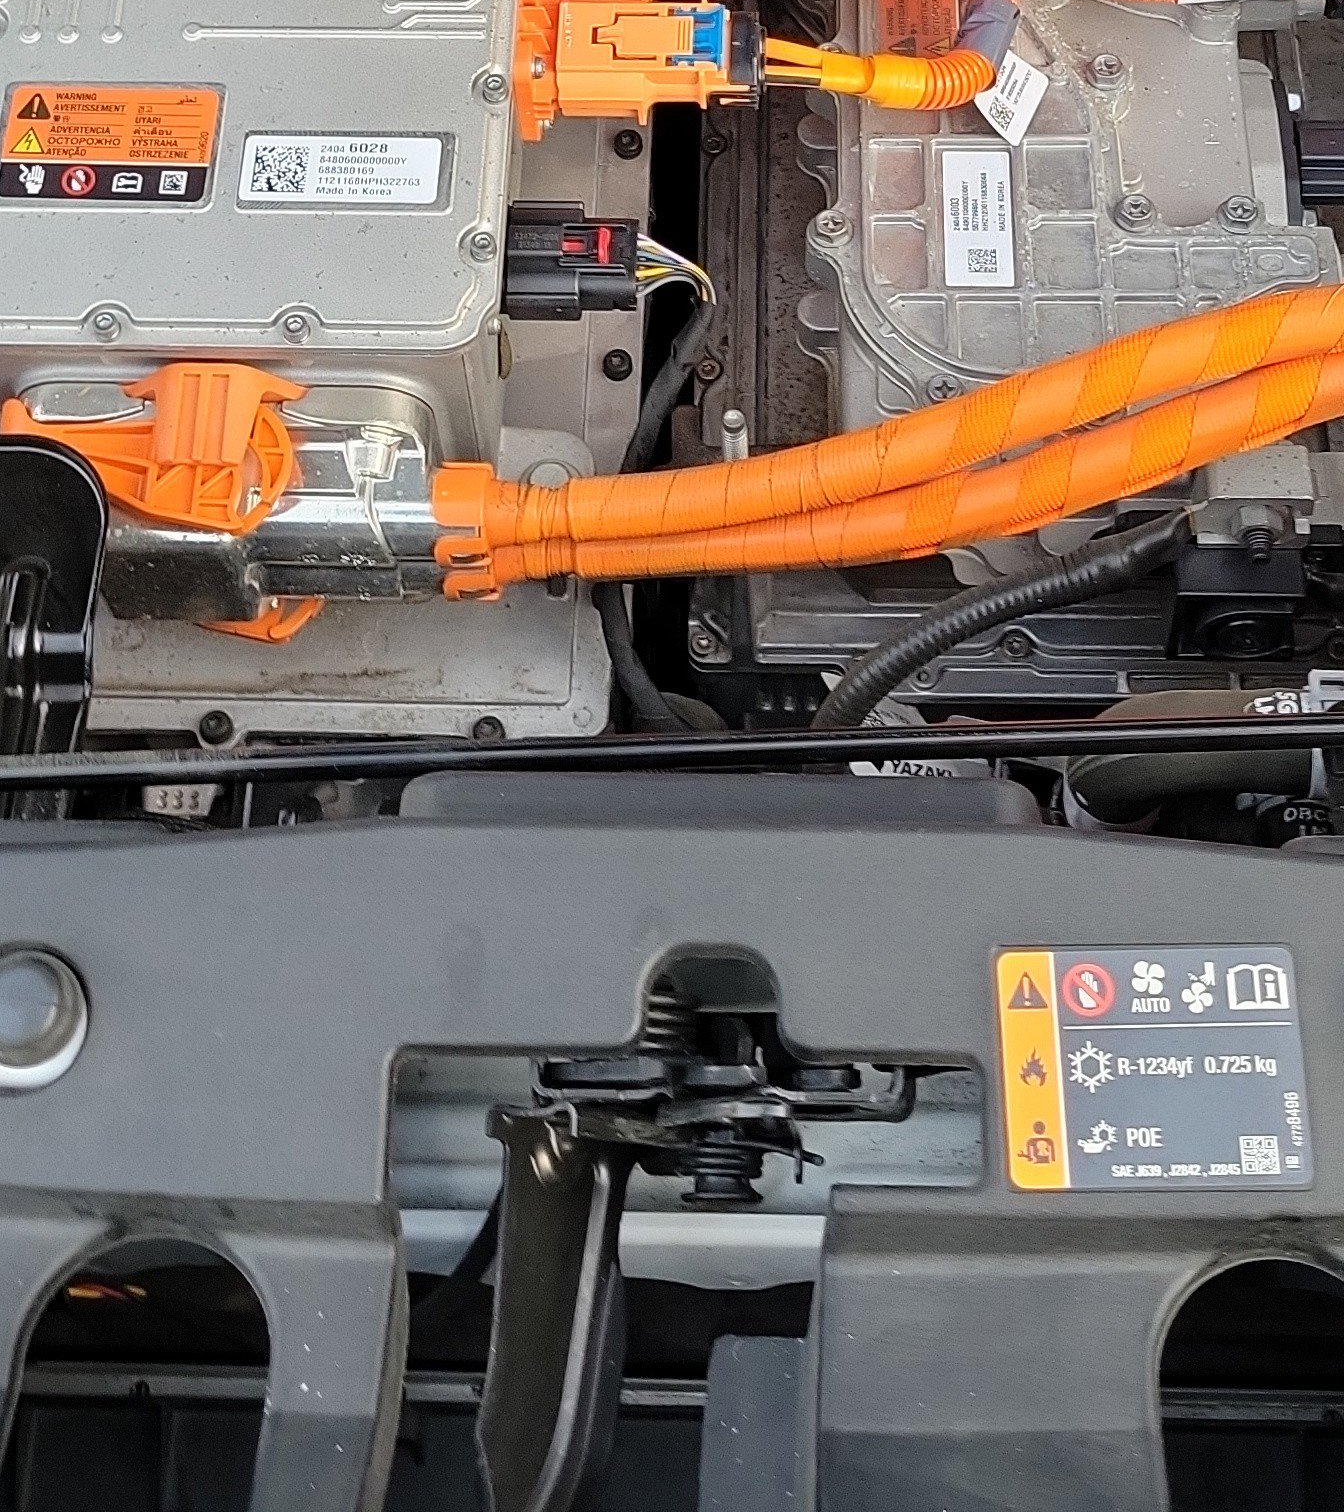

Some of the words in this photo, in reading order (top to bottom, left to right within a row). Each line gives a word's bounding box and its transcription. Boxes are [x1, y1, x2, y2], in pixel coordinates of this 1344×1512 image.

[56, 92, 96, 100] WARNING
[53, 102, 125, 113] AVERTISSEMENT
[50, 125, 110, 134] ADVERTENCIA
[349, 141, 388, 154] 6028
[316, 186, 343, 195] Made
[348, 187, 357, 195] In
[362, 187, 391, 196] Korea
[1132, 997, 1170, 1012] AUTO
[1117, 1057, 1194, 1078] R-1234yf
[1204, 1056, 1251, 1074] 0.725
[1254, 1055, 1277, 1076] kg
[1126, 1128, 1162, 1147] POE
[1112, 1165, 1134, 1177] SAE
